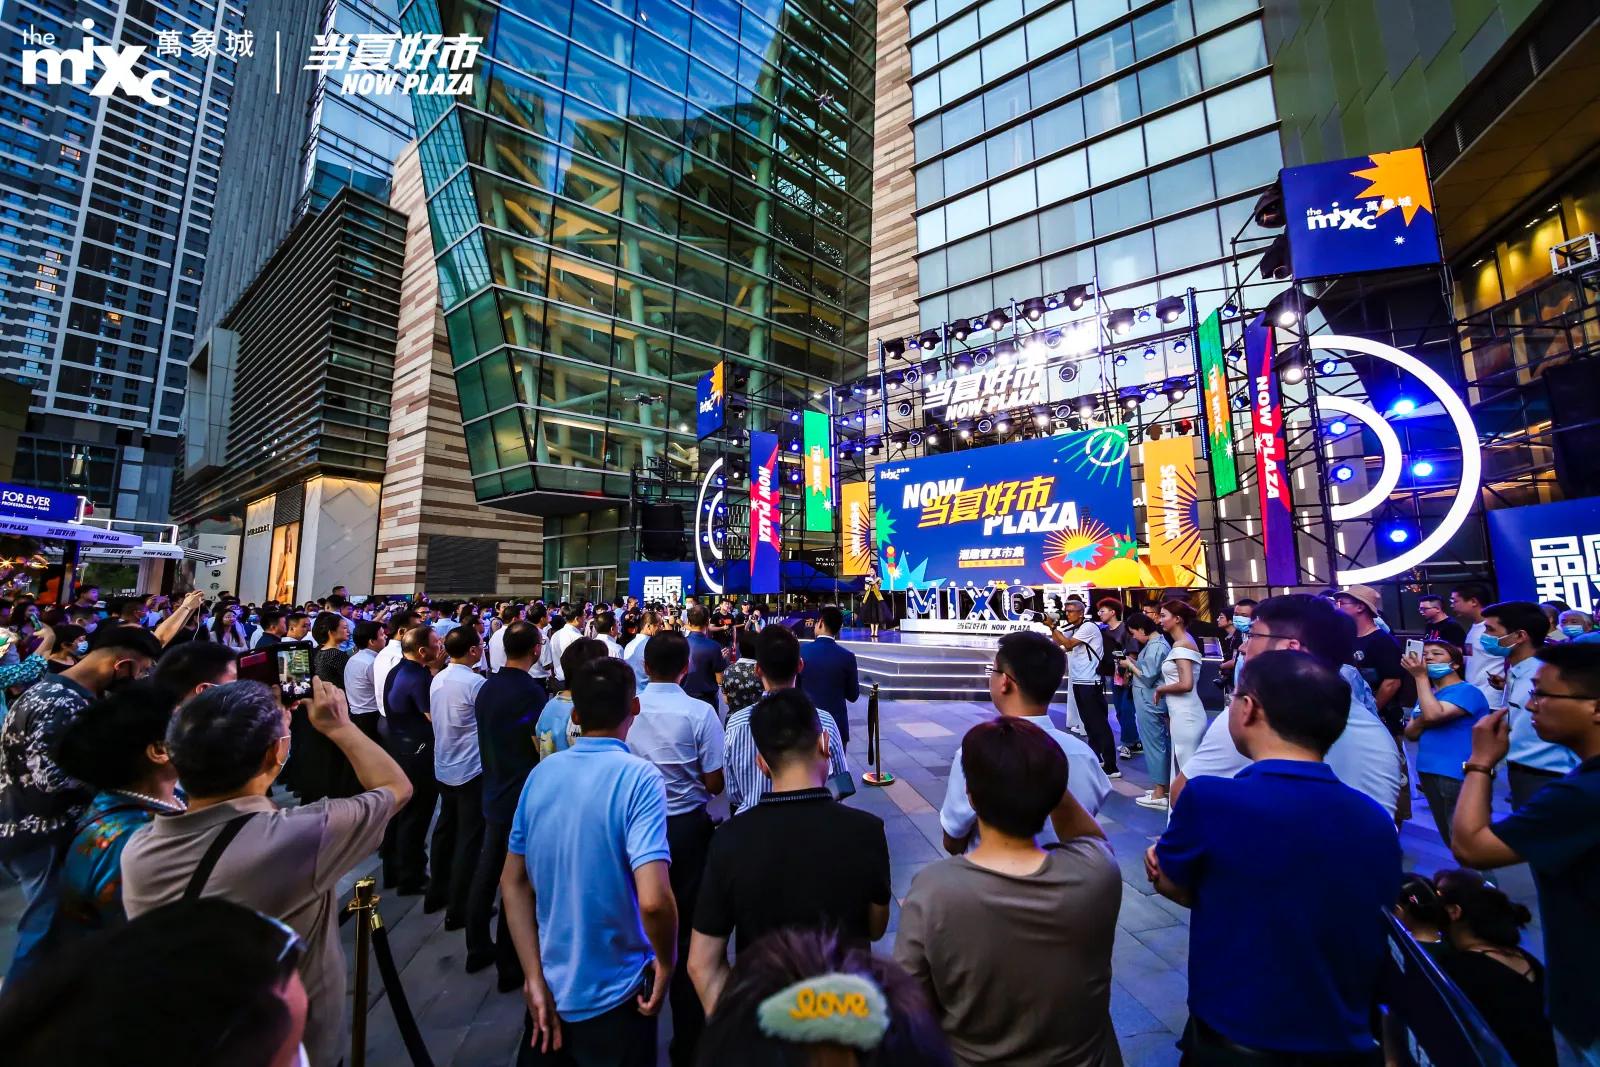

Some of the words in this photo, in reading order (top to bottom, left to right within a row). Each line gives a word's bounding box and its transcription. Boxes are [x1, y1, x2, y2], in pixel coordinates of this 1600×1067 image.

[945, 398, 984, 421] NOW
[1255, 375, 1272, 427] NOW
[759, 465, 771, 500] NOW
[1261, 433, 1280, 499] PLAZA
[2, 490, 24, 503] FOR
[26, 494, 50, 507] EVER
[903, 478, 964, 509] NOW
[9, 523, 29, 531] PLAZA
[758, 499, 771, 542] PLAZA
[984, 502, 1079, 536] PLAZA
[905, 584, 1036, 621] MIXC
[789, 987, 869, 1020] love
